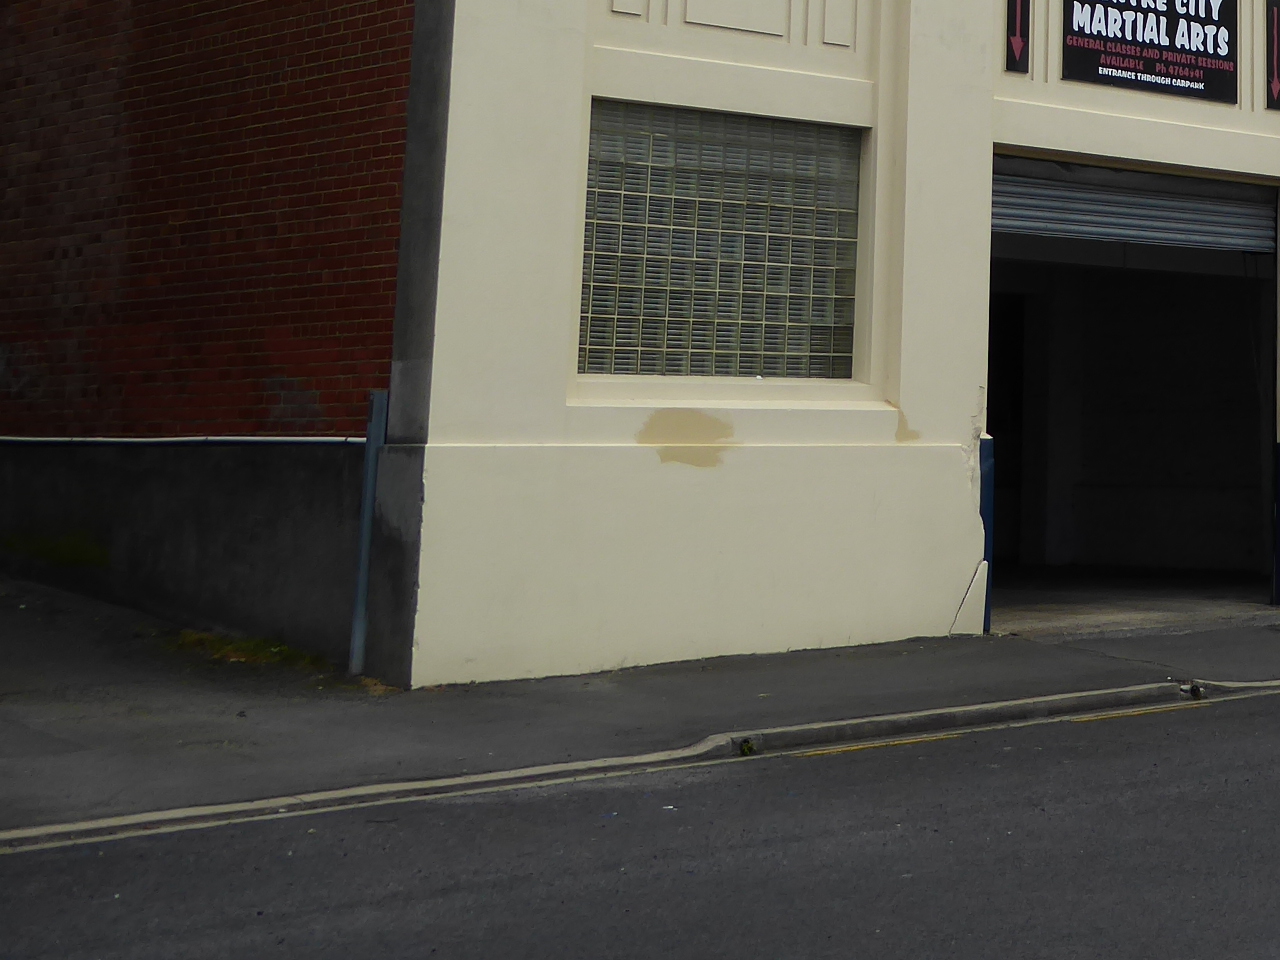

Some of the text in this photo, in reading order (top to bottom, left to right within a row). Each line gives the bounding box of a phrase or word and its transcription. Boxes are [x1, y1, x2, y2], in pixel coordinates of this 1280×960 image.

[1072, 0, 1229, 56] MARTIAL ARTS
[1066, 35, 1234, 72] GENERAL CLASSES AND PRIVATE SESSIONS
[1100, 53, 1144, 70] AVAILABLE
[1155, 62, 1167, 74] Ph
[1098, 66, 1205, 90] ENTRANCE THROUGH CARPARK
